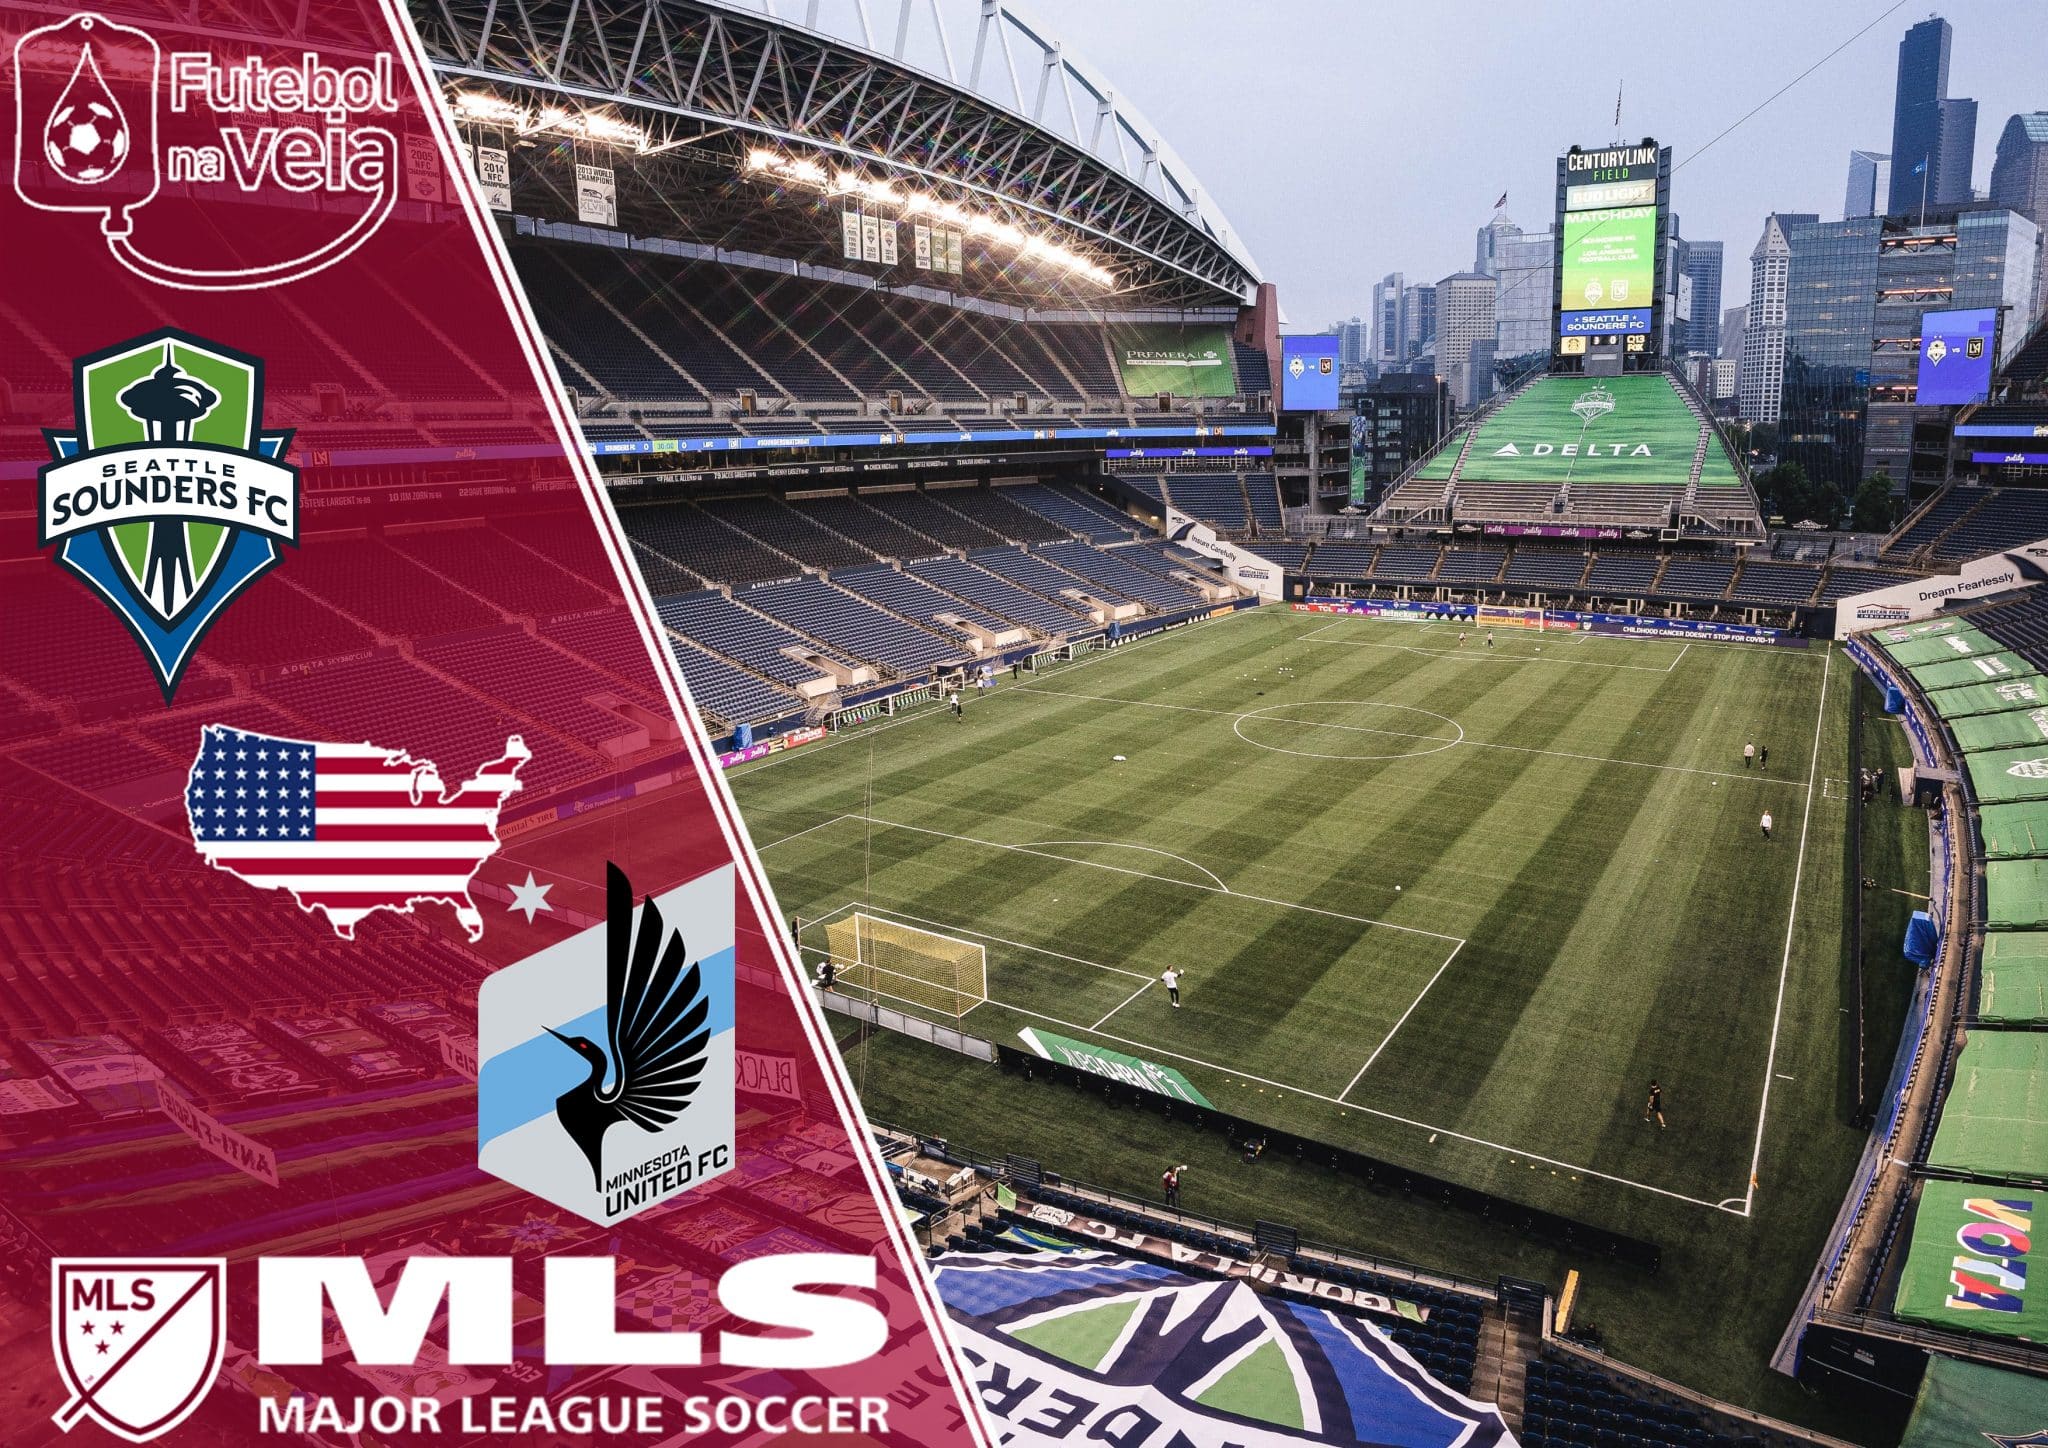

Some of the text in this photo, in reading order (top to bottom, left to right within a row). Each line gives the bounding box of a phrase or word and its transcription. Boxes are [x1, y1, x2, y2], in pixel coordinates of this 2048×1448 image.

[411, 150, 433, 161] 2005
[1568, 148, 1656, 171] CENTURYLINK
[415, 160, 431, 169] NFC
[483, 162, 504, 174] 2014
[487, 173, 502, 182] NFC
[577, 166, 613, 178] 2013 WORLD
[1594, 168, 1629, 181] FIELD
[577, 174, 614, 185] CHAMPIONS
[1566, 208, 1654, 223] MATCHDAY
[1582, 315, 1629, 324] SEATTLE
[1567, 321, 1645, 331] SOUNDERS FC
[1627, 344, 1644, 352] FOX
[1127, 350, 1195, 359] PREMERA
[1532, 443, 1652, 457] DELTA
[389, 493, 399, 502] 10
[459, 488, 468, 497] 22
[304, 498, 325, 508] STEVE
[326, 496, 355, 507] LARGENT
[1191, 534, 1237, 562] Insure Carefully
[1918, 572, 2015, 601] Dream Fearlessly
[1318, 605, 1334, 613] TCL
[1623, 625, 1776, 644] CHILDHOOD CANCER DOESN'T STOP FOR COVID-19
[292, 661, 324, 672] DELTA
[1081, 1219, 1146, 1249] FC
[1945, 1199, 2033, 1314] VOTA
[501, 1360, 544, 1384] ECS
